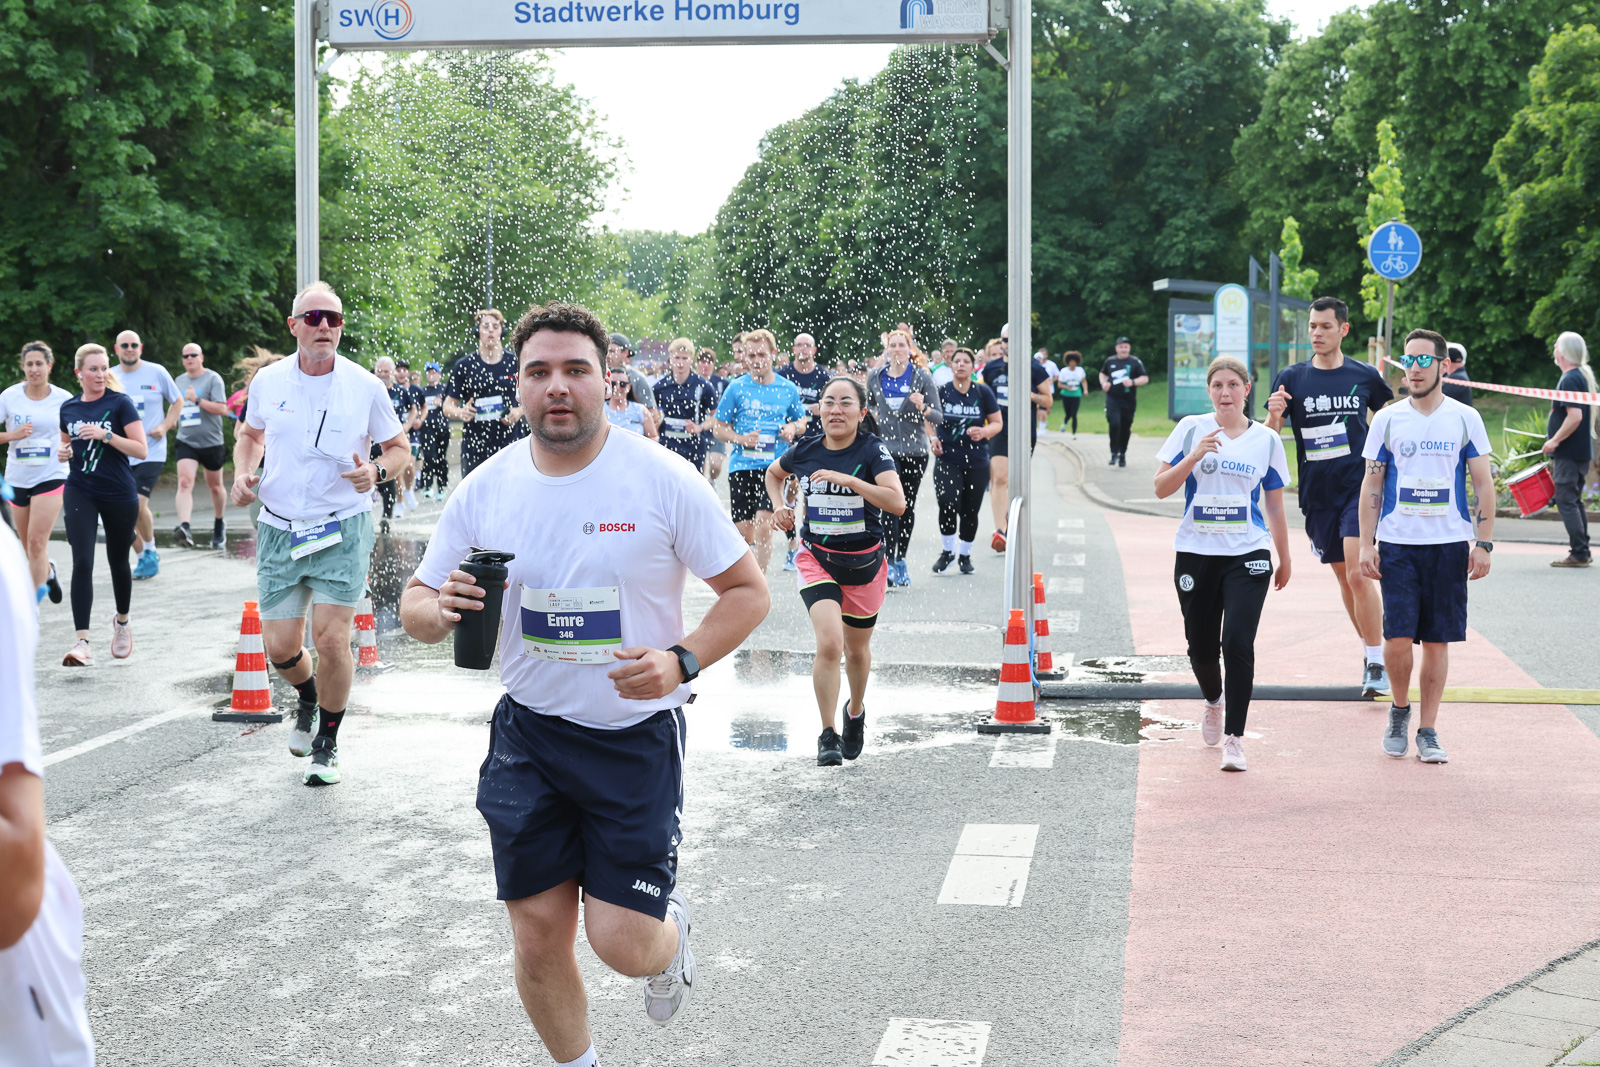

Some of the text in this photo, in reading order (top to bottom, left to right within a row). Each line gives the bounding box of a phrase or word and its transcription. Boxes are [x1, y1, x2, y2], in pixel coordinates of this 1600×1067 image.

[514, 0, 801, 26] Stadtwerke Homburg
[936, 0, 981, 14] TRINK
[919, 15, 984, 29] WASSER
[1333, 395, 1361, 410] UKS
[963, 406, 981, 415] UKS
[1314, 436, 1335, 446] Julian
[1420, 440, 1456, 452] COMET
[1221, 460, 1257, 476] COMET
[1411, 489, 1439, 498] Joshua
[818, 507, 854, 517] Elizabeth
[1202, 506, 1239, 515] Katharina
[296, 525, 326, 539] Michael
[599, 523, 636, 533] BOSCH
[547, 613, 585, 628] Emre
[558, 630, 575, 639] 346
[631, 879, 662, 898] JAKO
